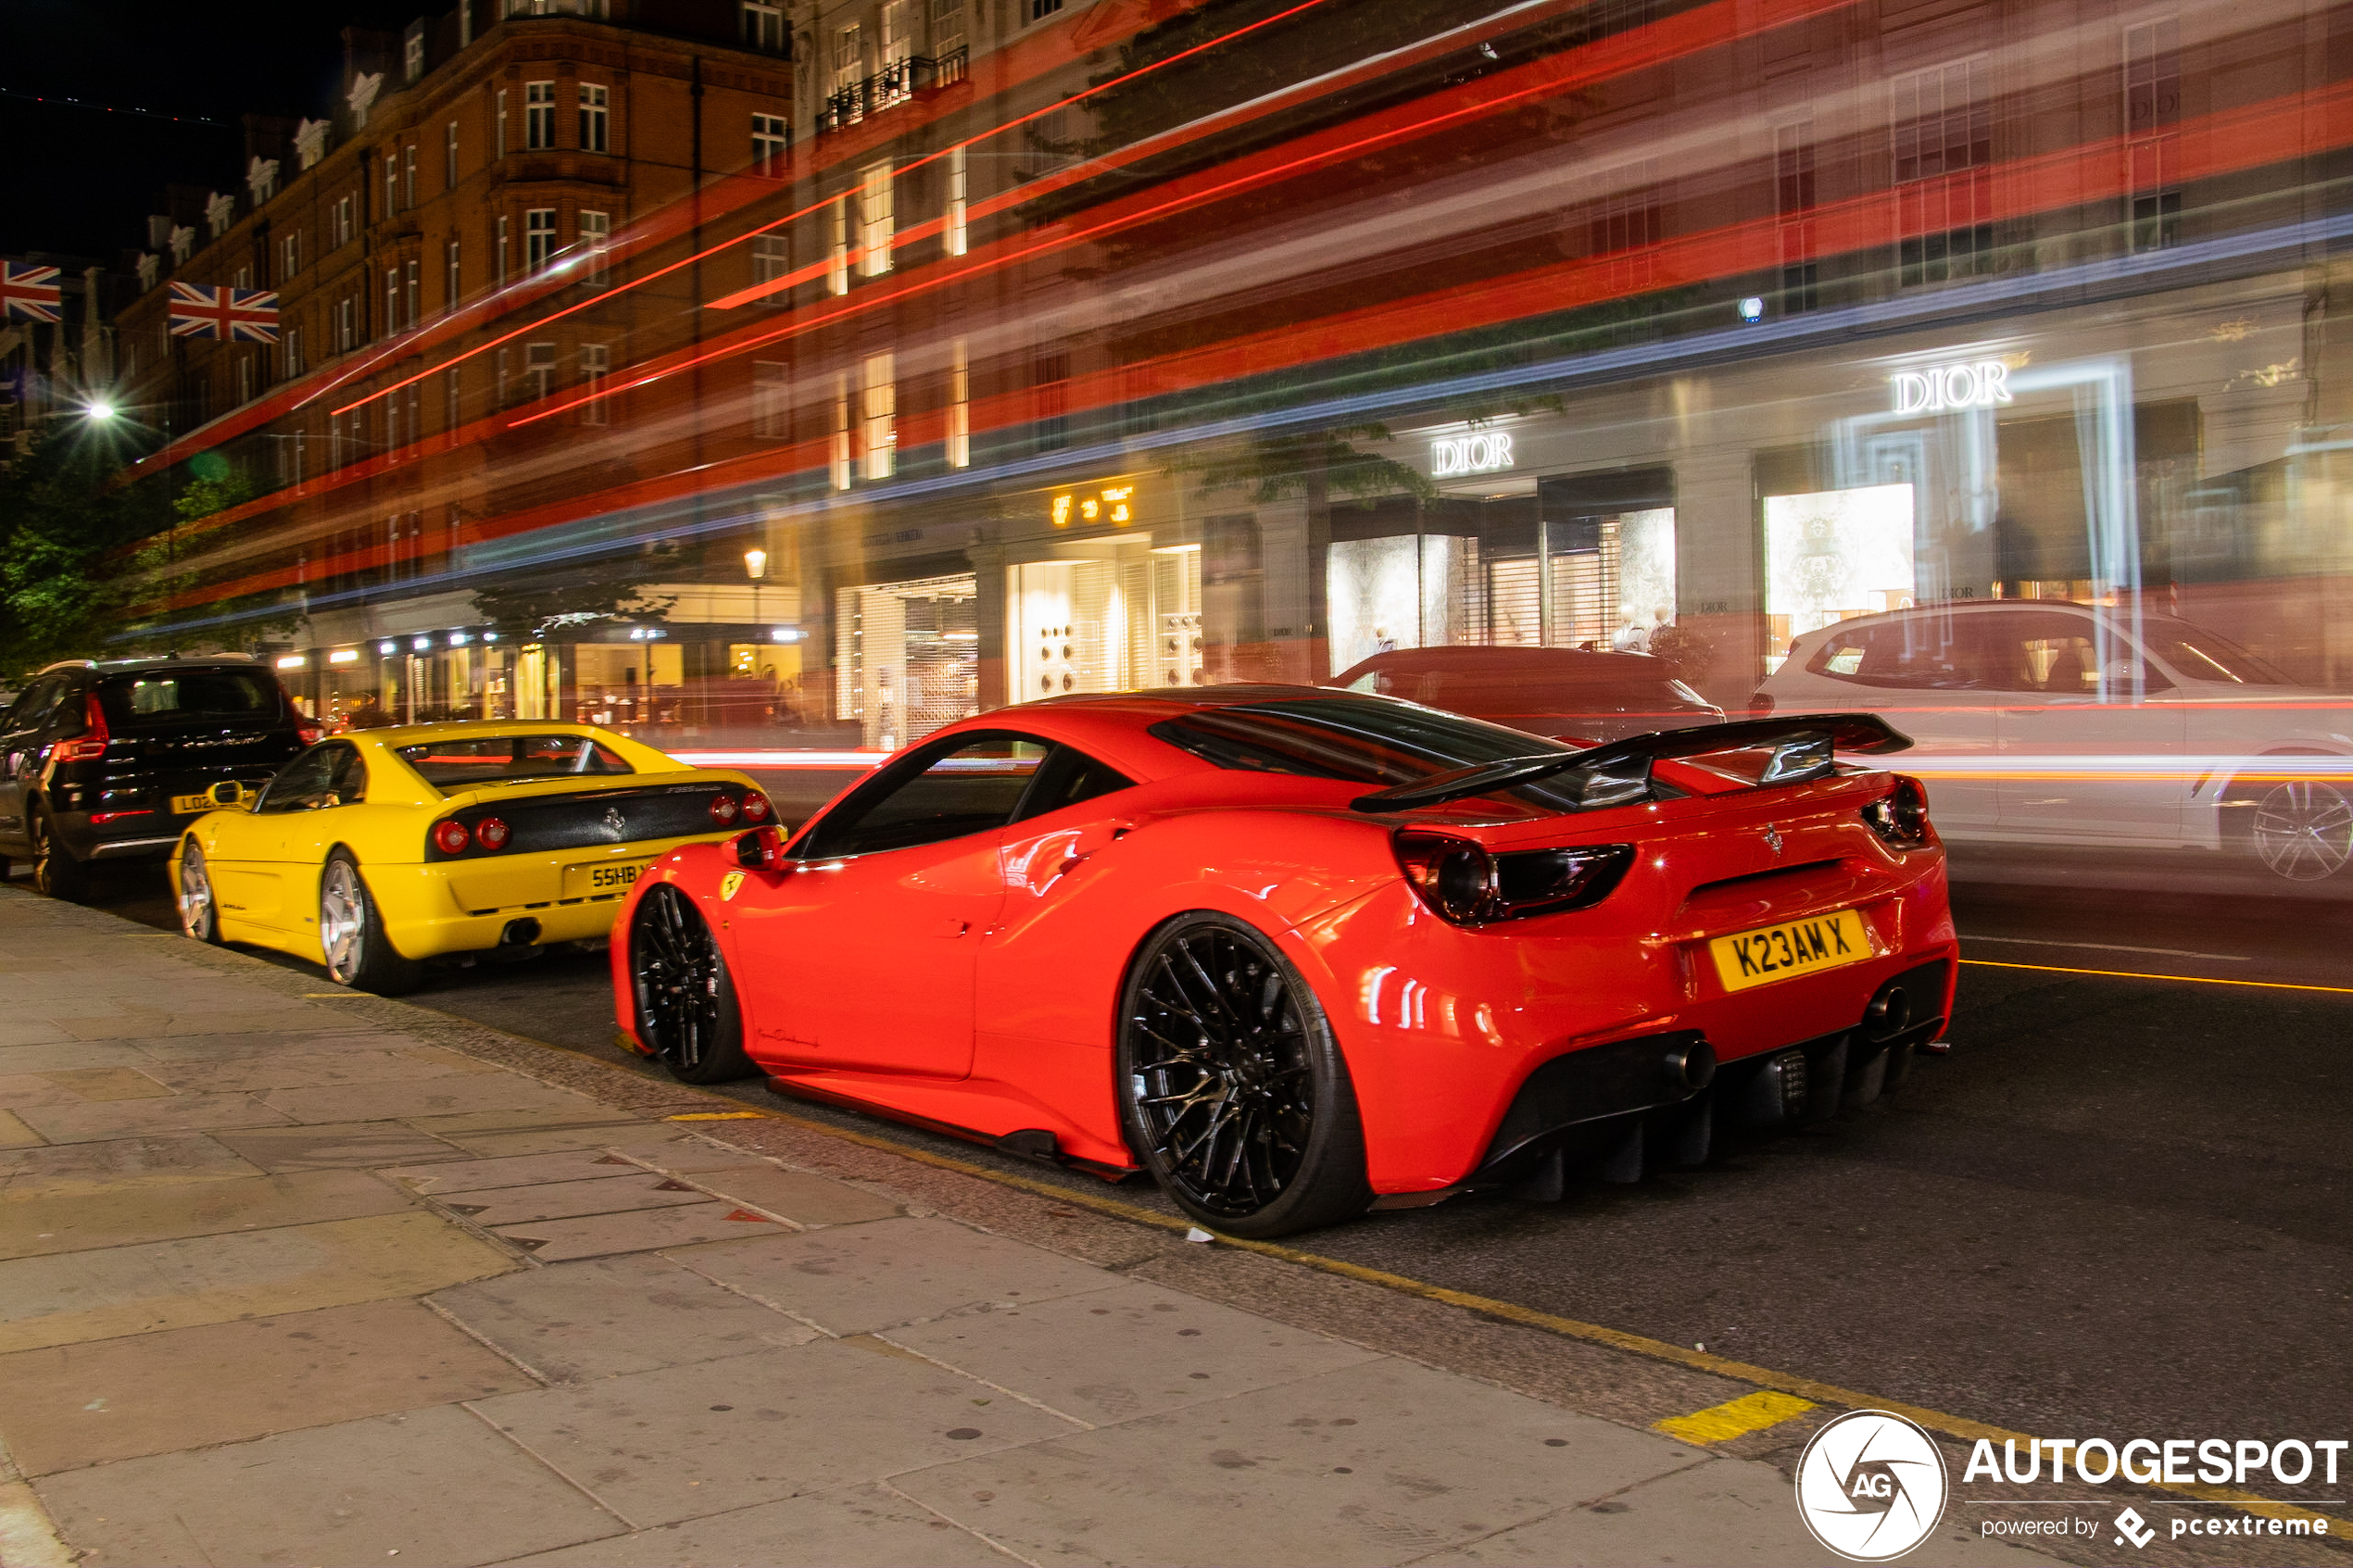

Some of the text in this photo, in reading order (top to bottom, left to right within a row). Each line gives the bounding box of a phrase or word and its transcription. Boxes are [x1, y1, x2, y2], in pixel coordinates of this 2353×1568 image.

[1891, 361, 2013, 415] DIOR
[1430, 432, 1515, 475] DIOR
[1701, 601, 1728, 613] DIOR
[1942, 586, 1974, 600] DIOR
[1826, 918, 1851, 955] X
